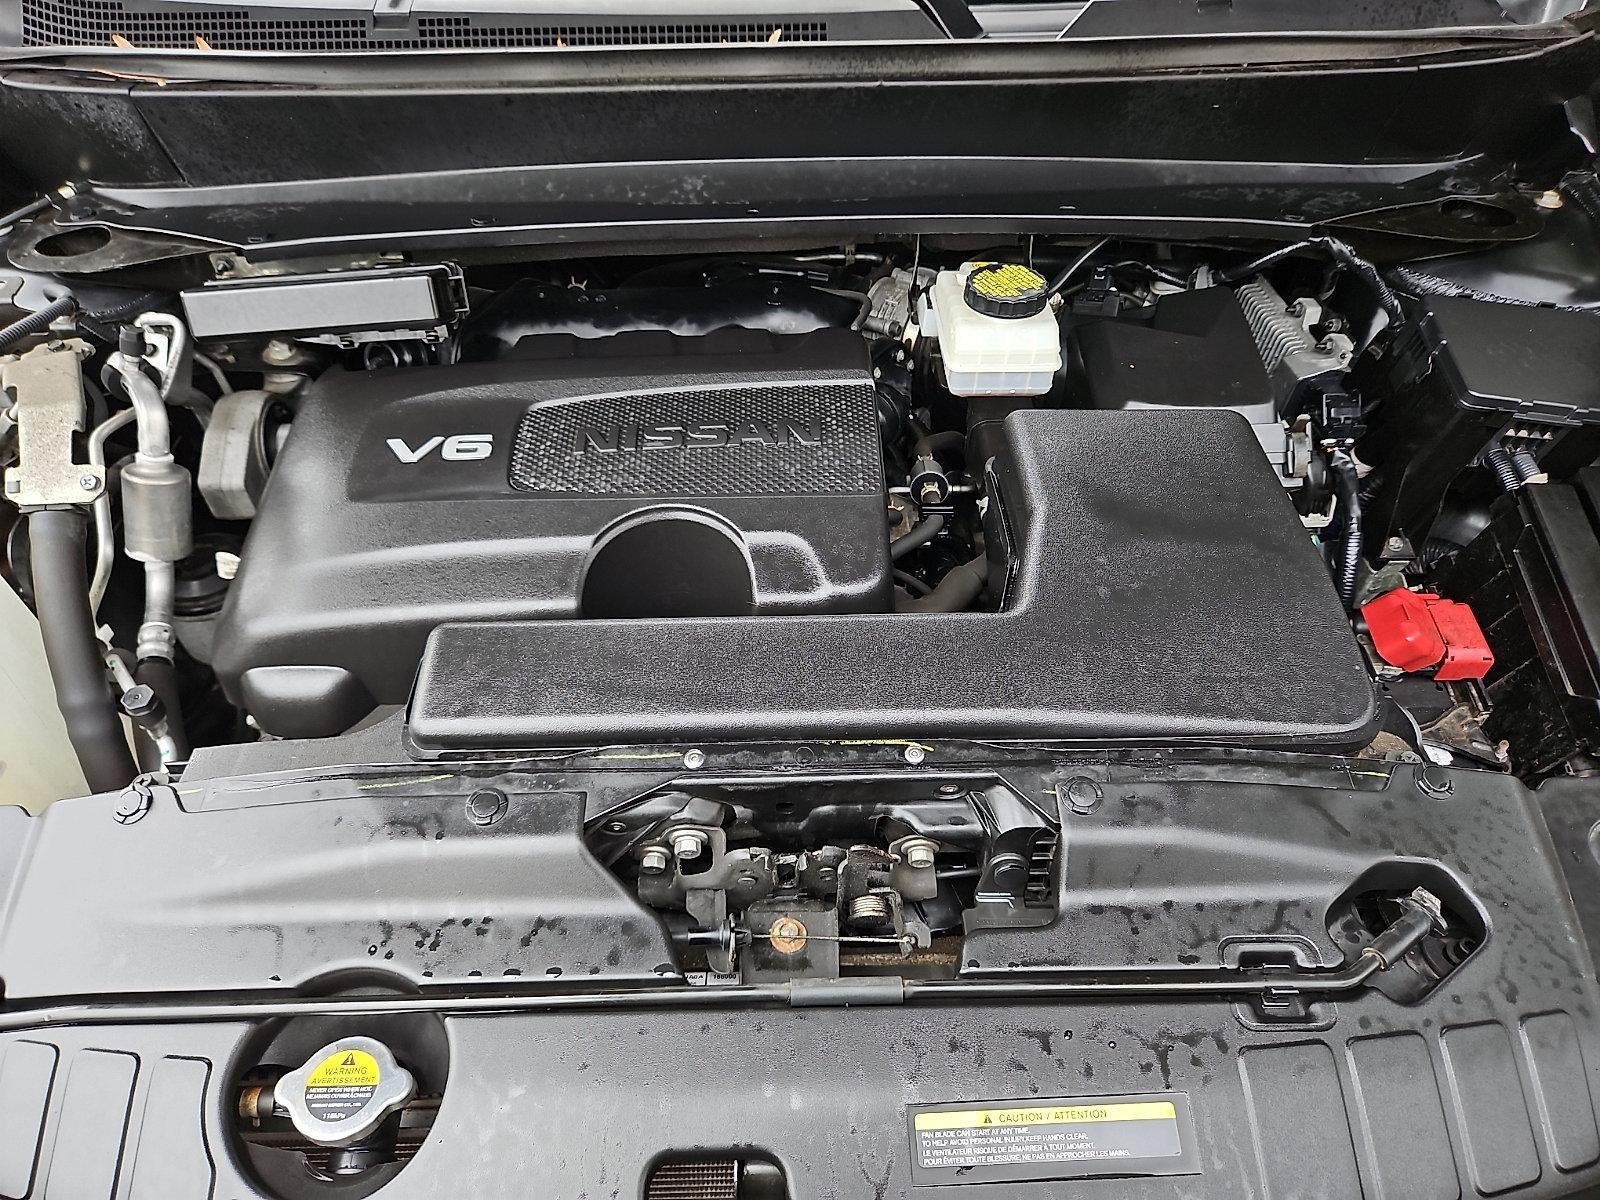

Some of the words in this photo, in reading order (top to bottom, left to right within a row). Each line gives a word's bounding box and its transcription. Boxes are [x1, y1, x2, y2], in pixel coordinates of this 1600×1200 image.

[386, 434, 493, 463] V6
[574, 418, 822, 456] NISSAN
[325, 1066, 368, 1076] WARNING
[311, 1076, 376, 1085] AVERTISSEMENT
[999, 1112, 1043, 1122] CAUTION
[1054, 1110, 1107, 1120] ATTENTION
[950, 1138, 970, 1146] AVOID
[931, 1147, 972, 1156] VENTILATEUR
[973, 1146, 997, 1154] RISQUE
[1008, 1144, 1042, 1152] DÉMARRER
[1043, 1143, 1048, 1151] À
[1067, 1142, 1095, 1150] MOMENT.
[943, 1156, 964, 1164] ÉVITER
[1056, 1151, 1096, 1159] APPROCHER
